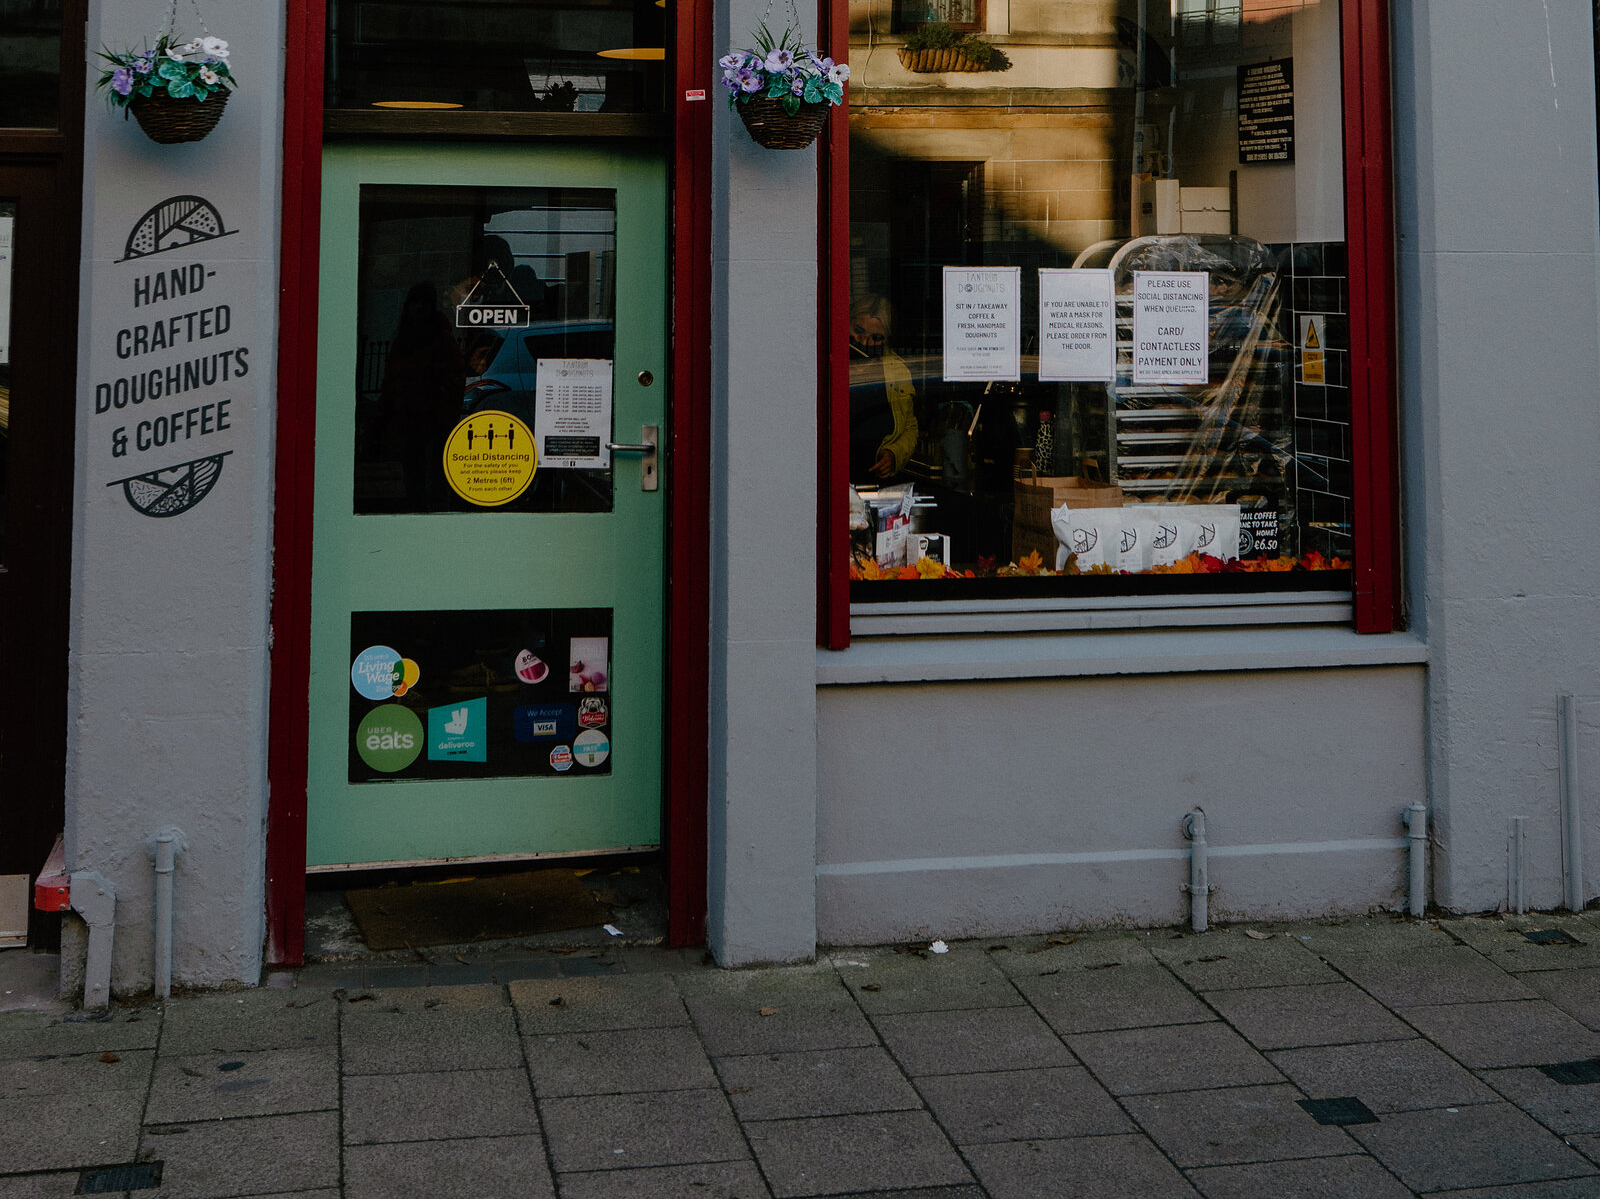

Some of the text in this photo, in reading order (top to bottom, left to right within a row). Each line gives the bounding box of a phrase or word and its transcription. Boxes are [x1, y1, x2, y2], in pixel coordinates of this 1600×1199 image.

[966, 272, 998, 282] TANTRUM
[133, 263, 217, 308] HAND-
[958, 283, 1005, 293] DOUGHNUTS
[1147, 280, 1191, 288] PLEASE USE
[1137, 292, 1203, 301] SOCIAL DISTANCING
[1144, 305, 1164, 313] WHEN
[469, 309, 517, 324] OPEN
[116, 304, 231, 359] CRAFTED
[1158, 327, 1184, 336] CARD/
[1140, 342, 1201, 351] CONTACTLESS
[1138, 357, 1202, 366] PAYMENT ONLY
[95, 347, 249, 415] DOUGHNUTS
[112, 399, 232, 458] & COFFEE
[452, 453, 530, 462] Social Distancing
[1254, 511, 1277, 520] COFFEE
[1256, 527, 1278, 537] HOME!
[358, 661, 394, 673] Living
[366, 671, 400, 684] Wage
[527, 709, 562, 717] We Accept
[366, 731, 414, 750] eats
[438, 741, 475, 750] deliveroo
